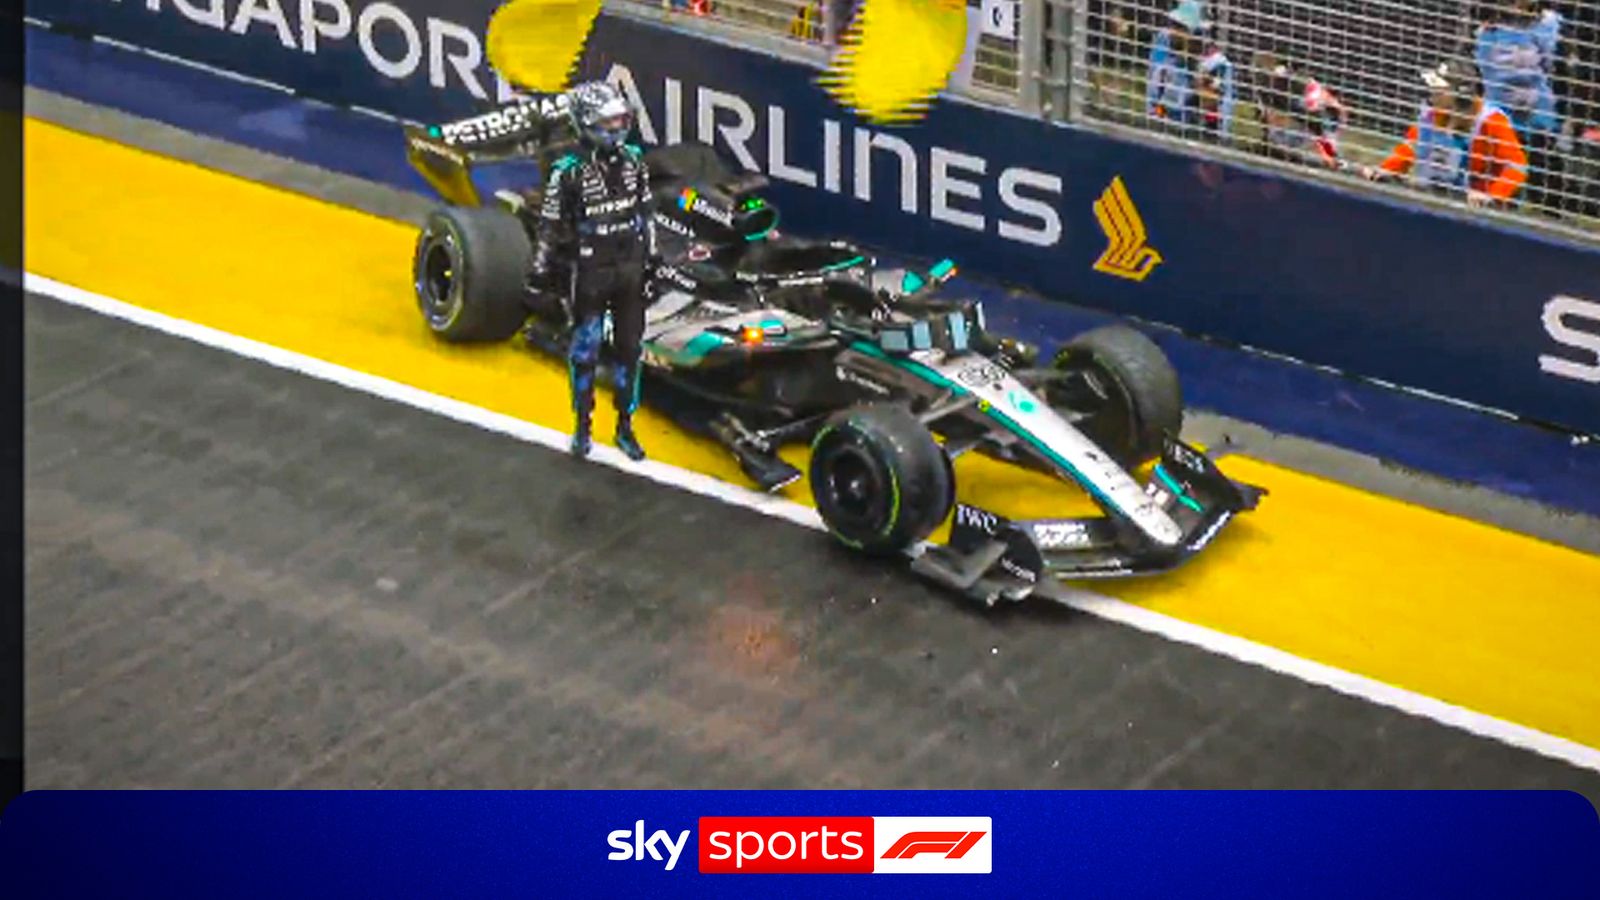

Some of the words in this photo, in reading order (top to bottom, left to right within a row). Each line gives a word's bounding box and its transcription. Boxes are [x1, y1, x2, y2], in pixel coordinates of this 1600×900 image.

[112, 0, 535, 103] APOR
[603, 62, 1063, 247] AIRLINES
[957, 504, 997, 536] IWC
